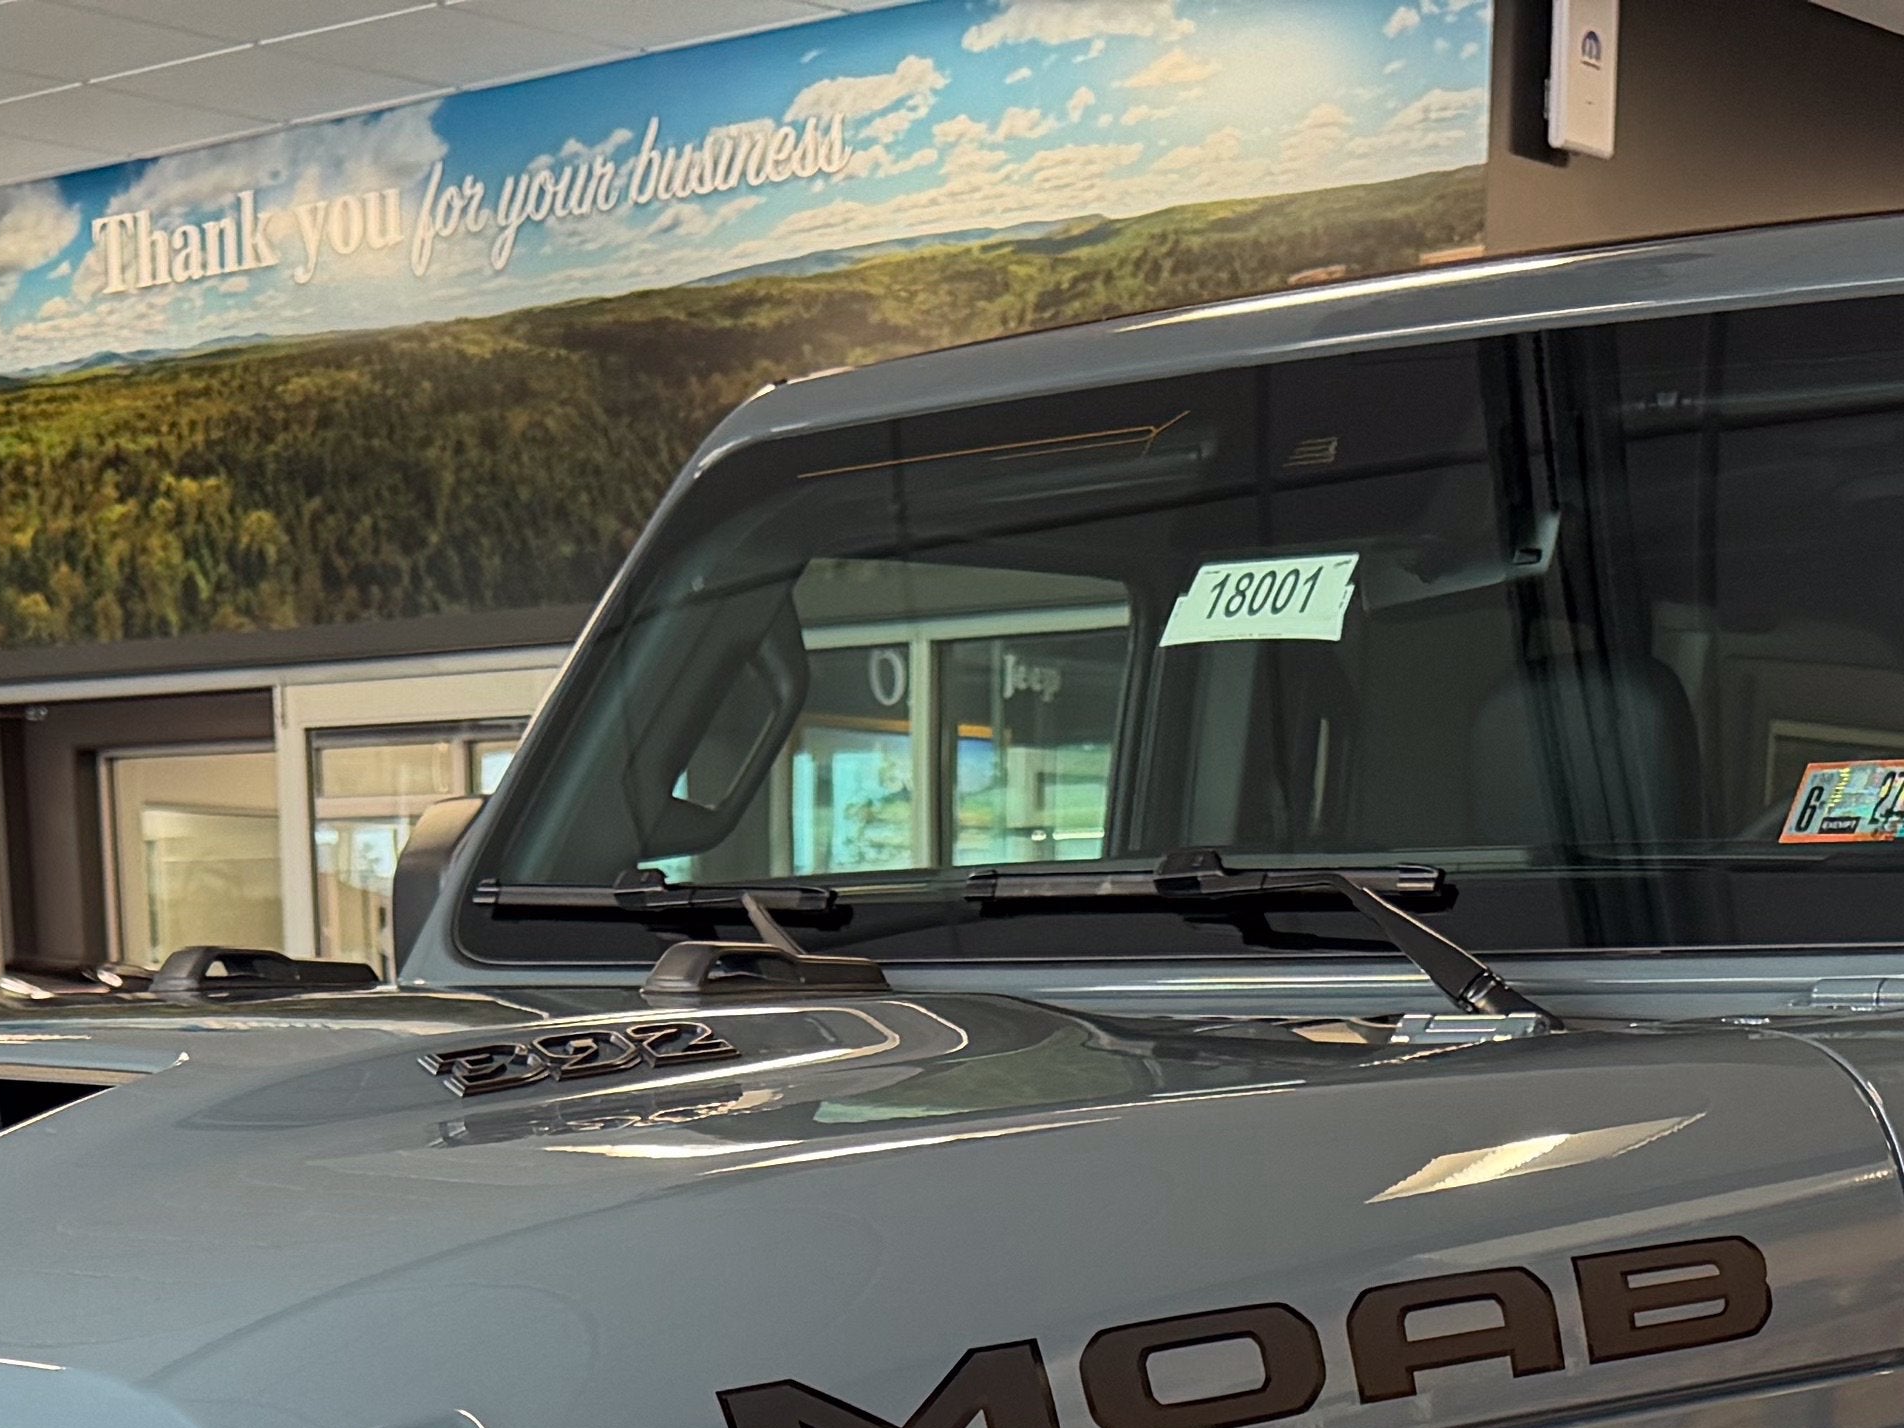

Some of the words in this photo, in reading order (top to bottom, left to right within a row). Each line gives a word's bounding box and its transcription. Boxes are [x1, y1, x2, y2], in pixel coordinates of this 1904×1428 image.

[92, 191, 281, 296] Thank
[293, 186, 404, 284] you
[409, 160, 491, 277] for
[494, 160, 619, 271] your
[628, 116, 854, 205] business
[1206, 565, 1324, 620] 18001
[1795, 785, 1825, 833] 6
[416, 1020, 742, 1099] 392
